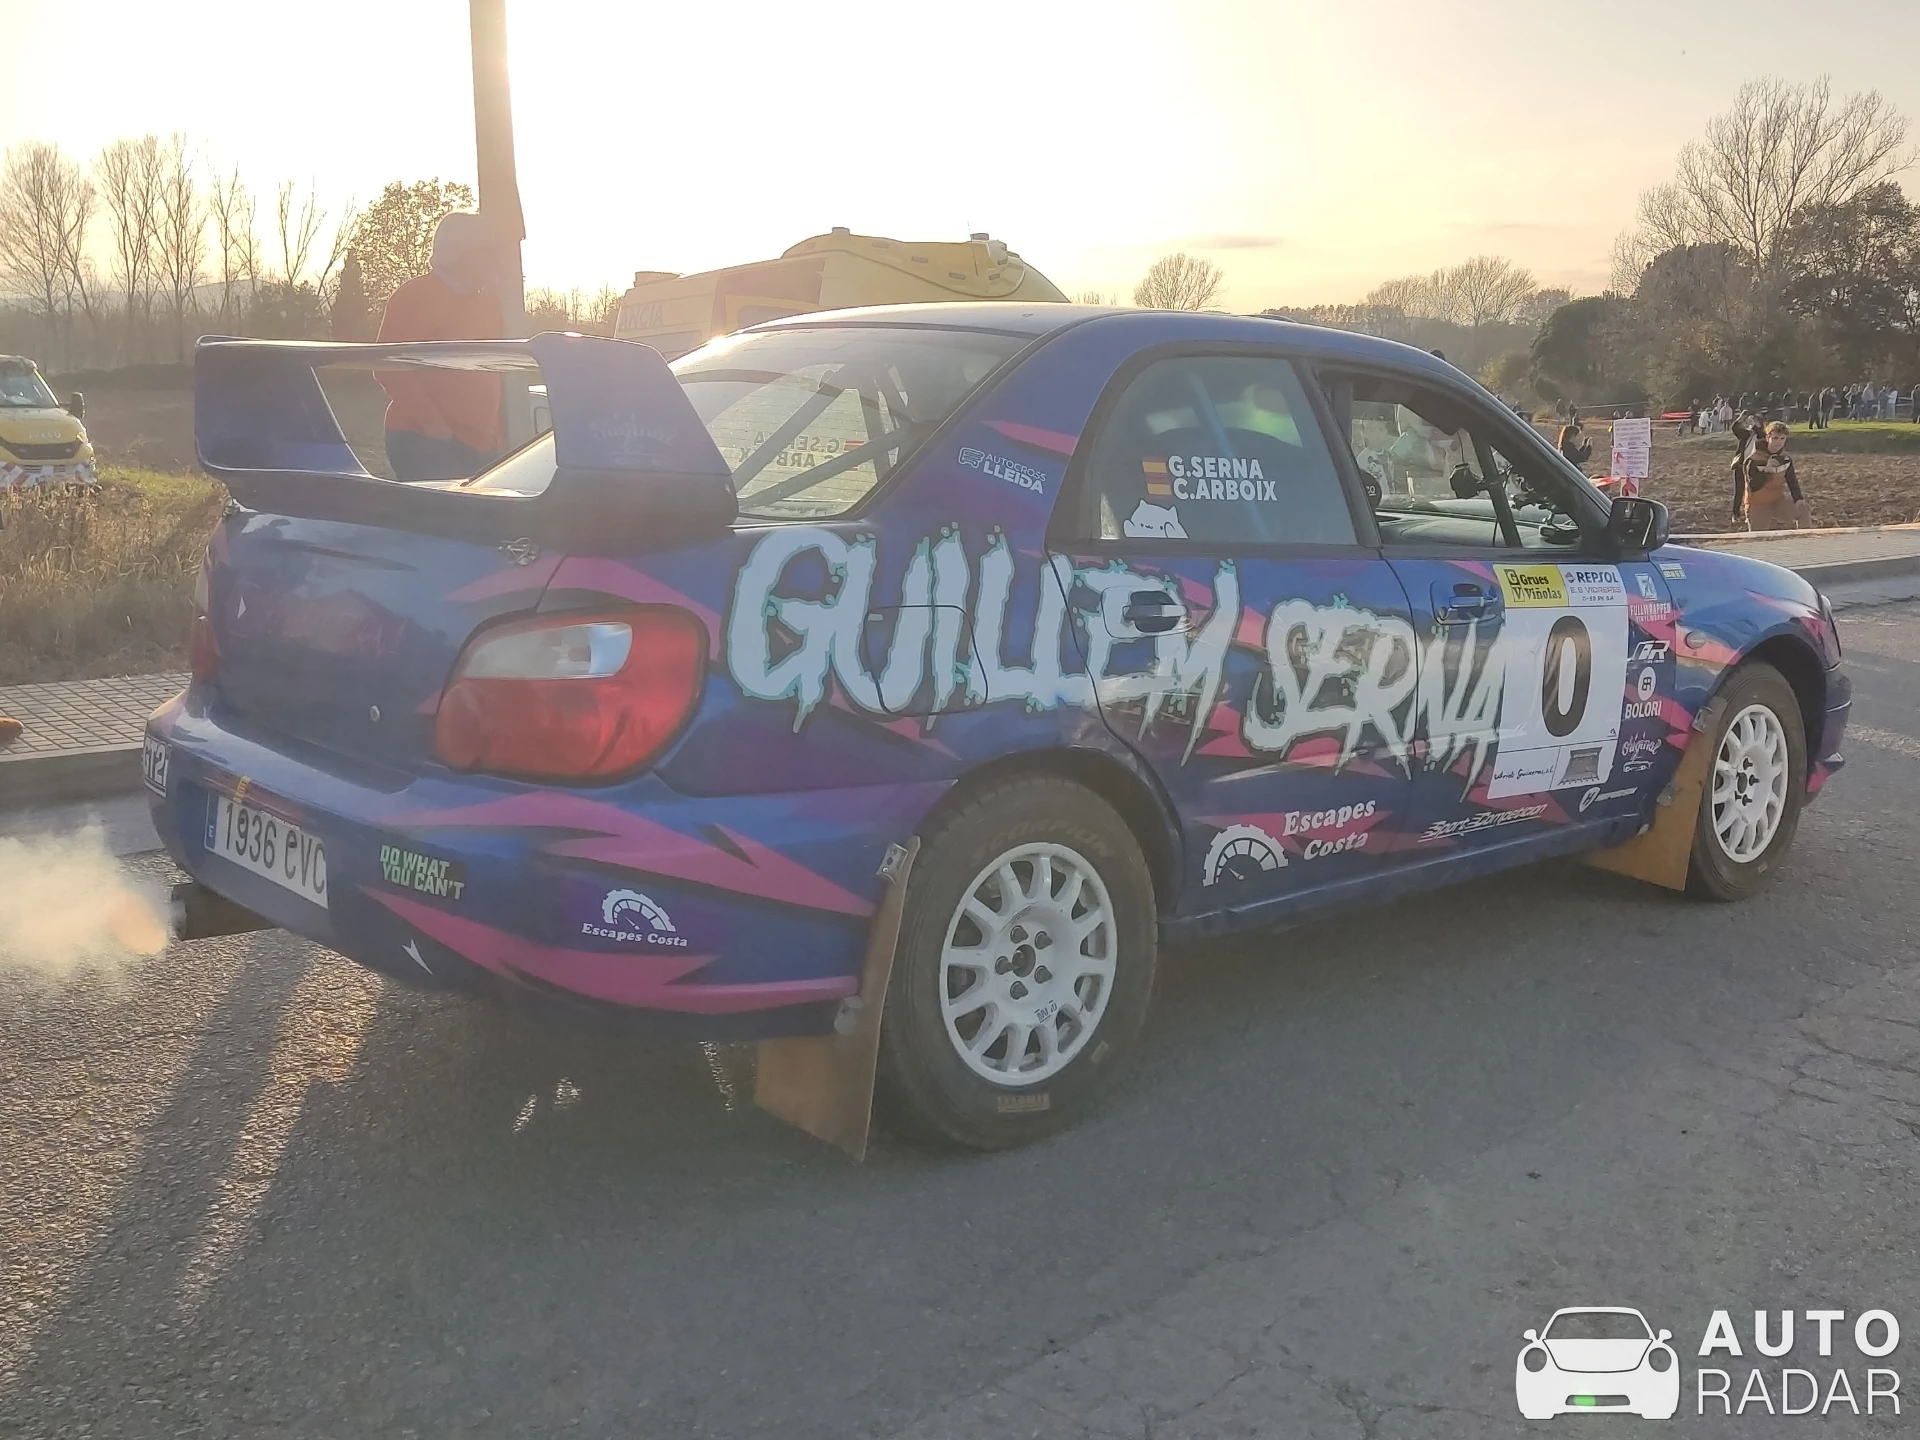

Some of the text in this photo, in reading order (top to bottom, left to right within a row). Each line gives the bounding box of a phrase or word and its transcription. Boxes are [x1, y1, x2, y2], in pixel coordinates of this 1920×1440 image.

[983, 460, 1044, 495] LLEIDA
[985, 453, 1047, 482] AUTOCROSS
[1168, 455, 1264, 480] G.SERNA
[1173, 478, 1278, 502] C.ARBOIX
[1520, 574, 1549, 586] Grues
[1576, 571, 1619, 583] REPSOL
[1524, 586, 1562, 600] Viñolas
[727, 524, 1243, 767] GUILLEM
[1541, 615, 1592, 737] 0
[1242, 595, 1503, 803] SERNA
[1624, 700, 1662, 719] BOLORI
[1282, 799, 1377, 837] Escapes
[222, 802, 277, 869] 1936
[1303, 830, 1369, 861] Costa
[380, 844, 450, 879] DO WHAT
[382, 861, 465, 900] YOU CAN'T
[581, 922, 688, 947] Escapes Costa
